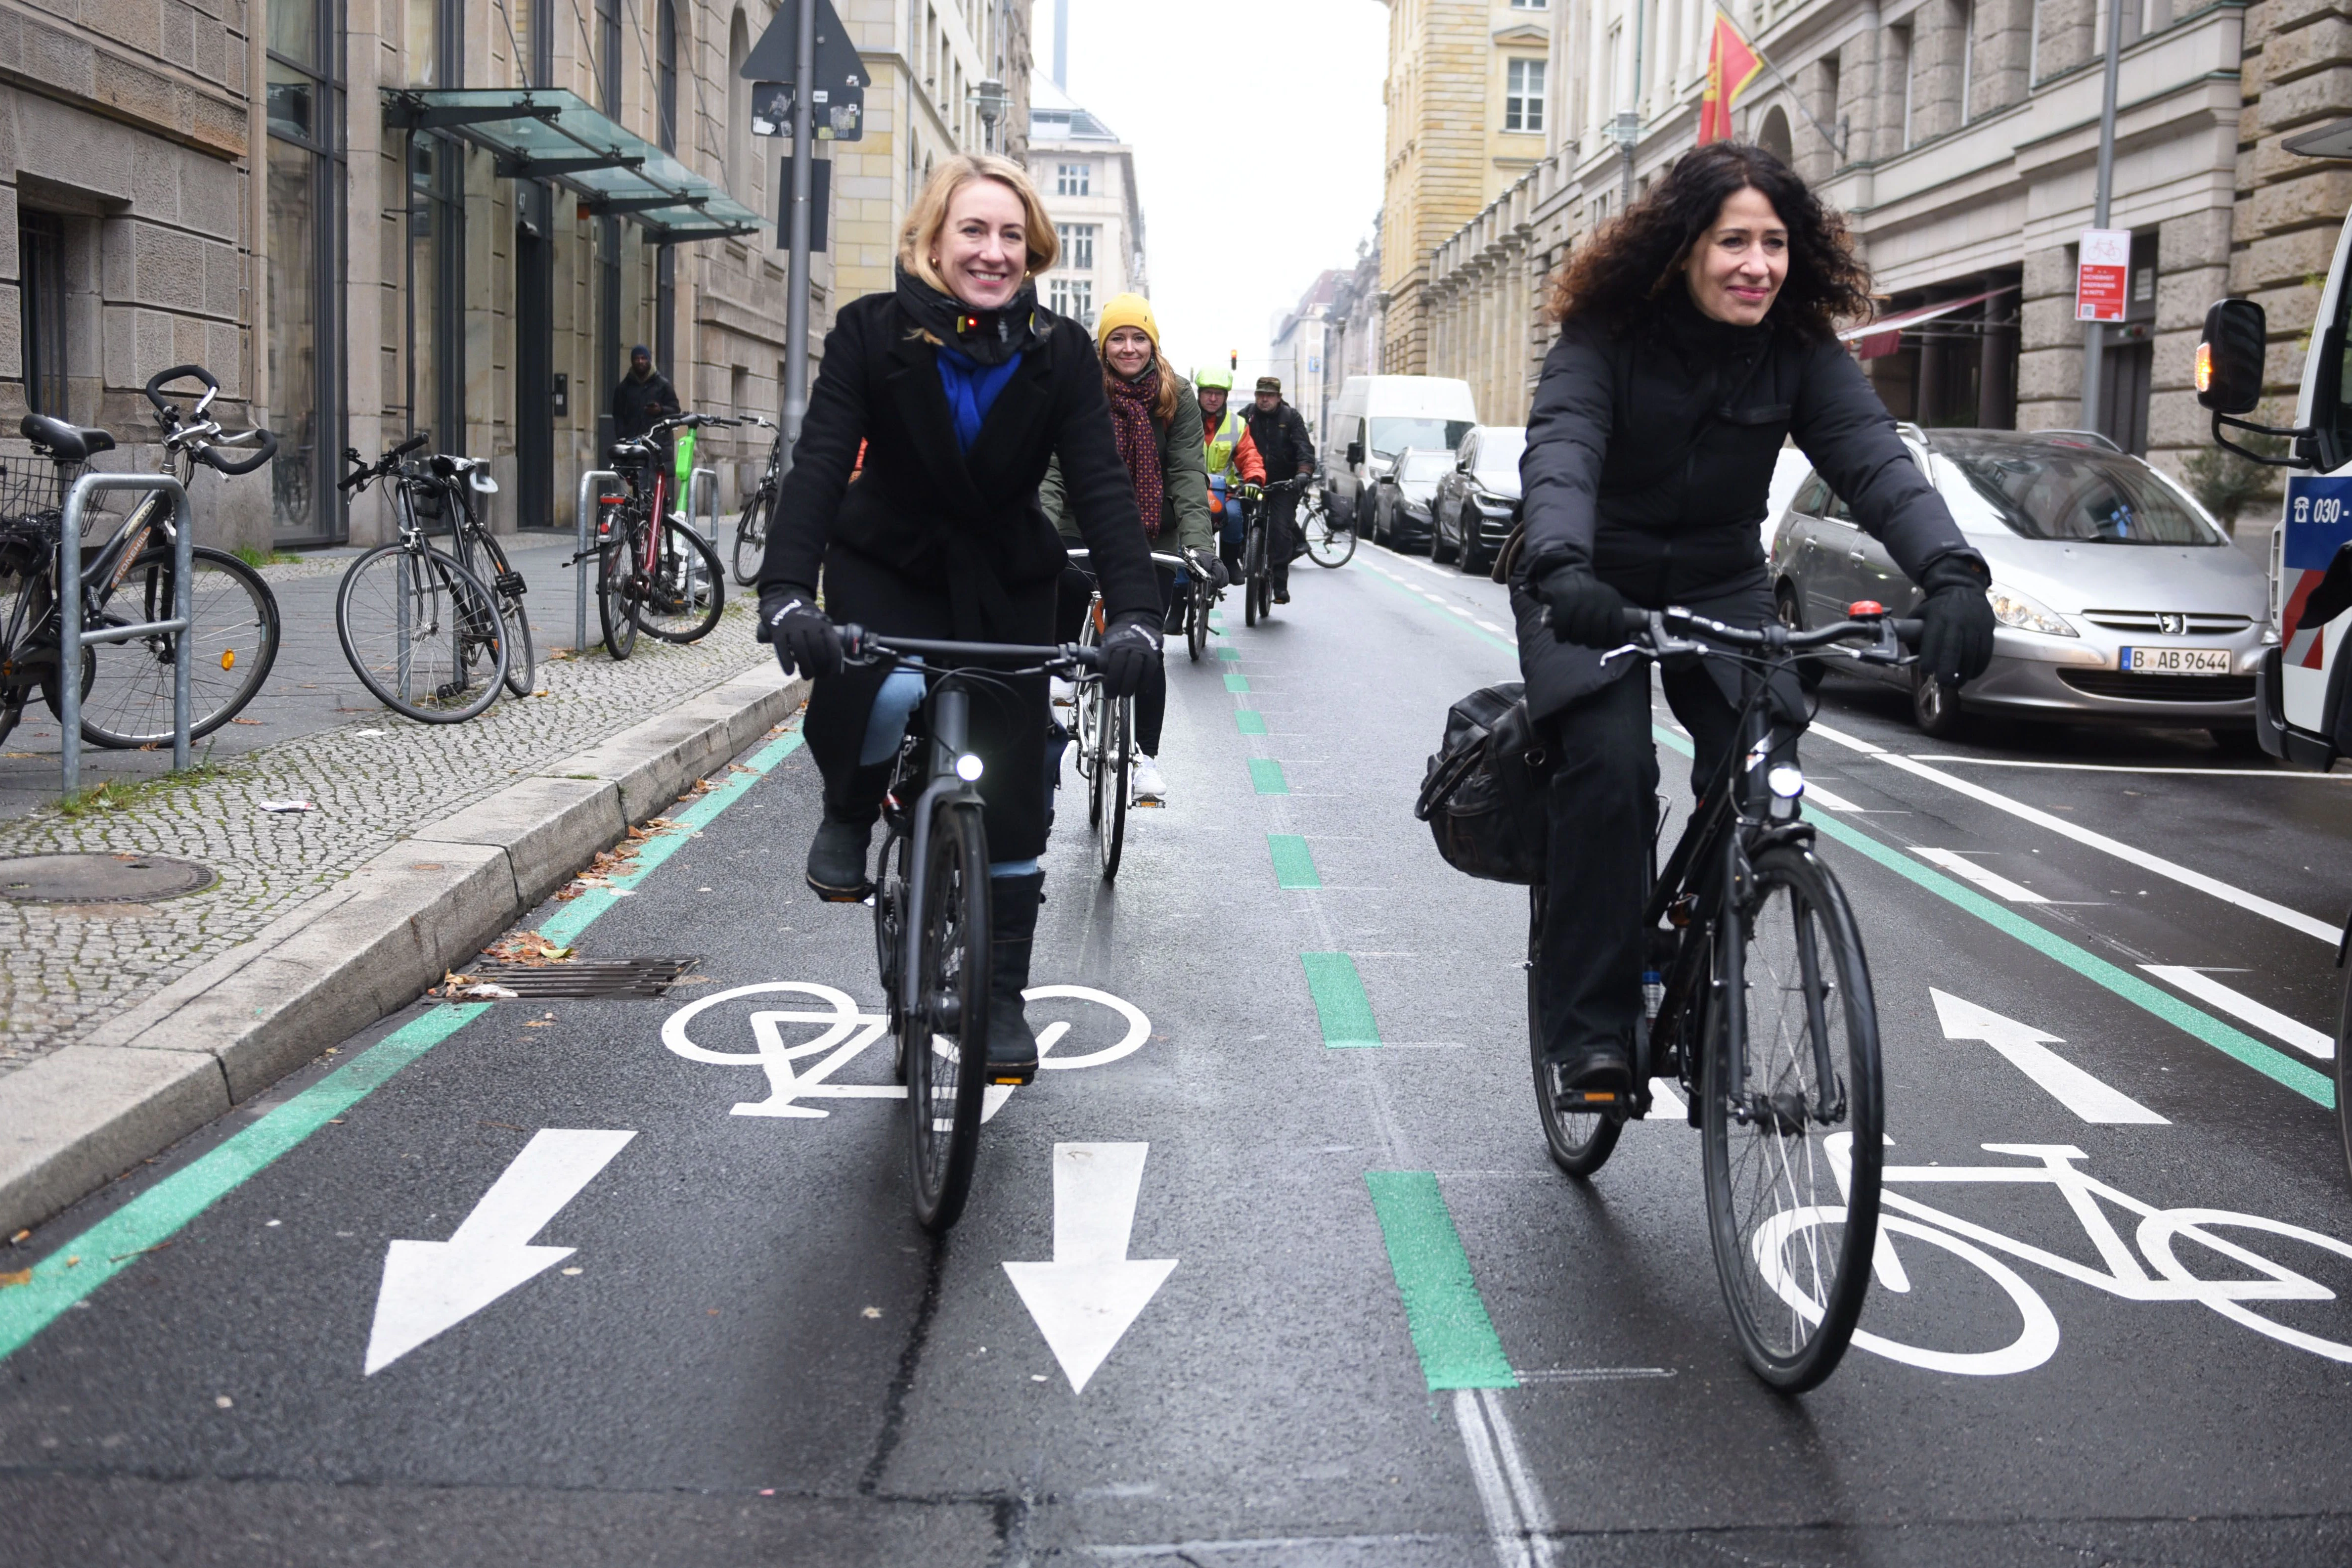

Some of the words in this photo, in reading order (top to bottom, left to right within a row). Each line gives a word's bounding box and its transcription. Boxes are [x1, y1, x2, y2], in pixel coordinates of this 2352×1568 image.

[2313, 498, 2340, 523] 030
[113, 530, 150, 584] STONEHILL
[2133, 651, 2144, 668] B
[2157, 651, 2180, 669] AB
[2185, 652, 2227, 670] 9644
